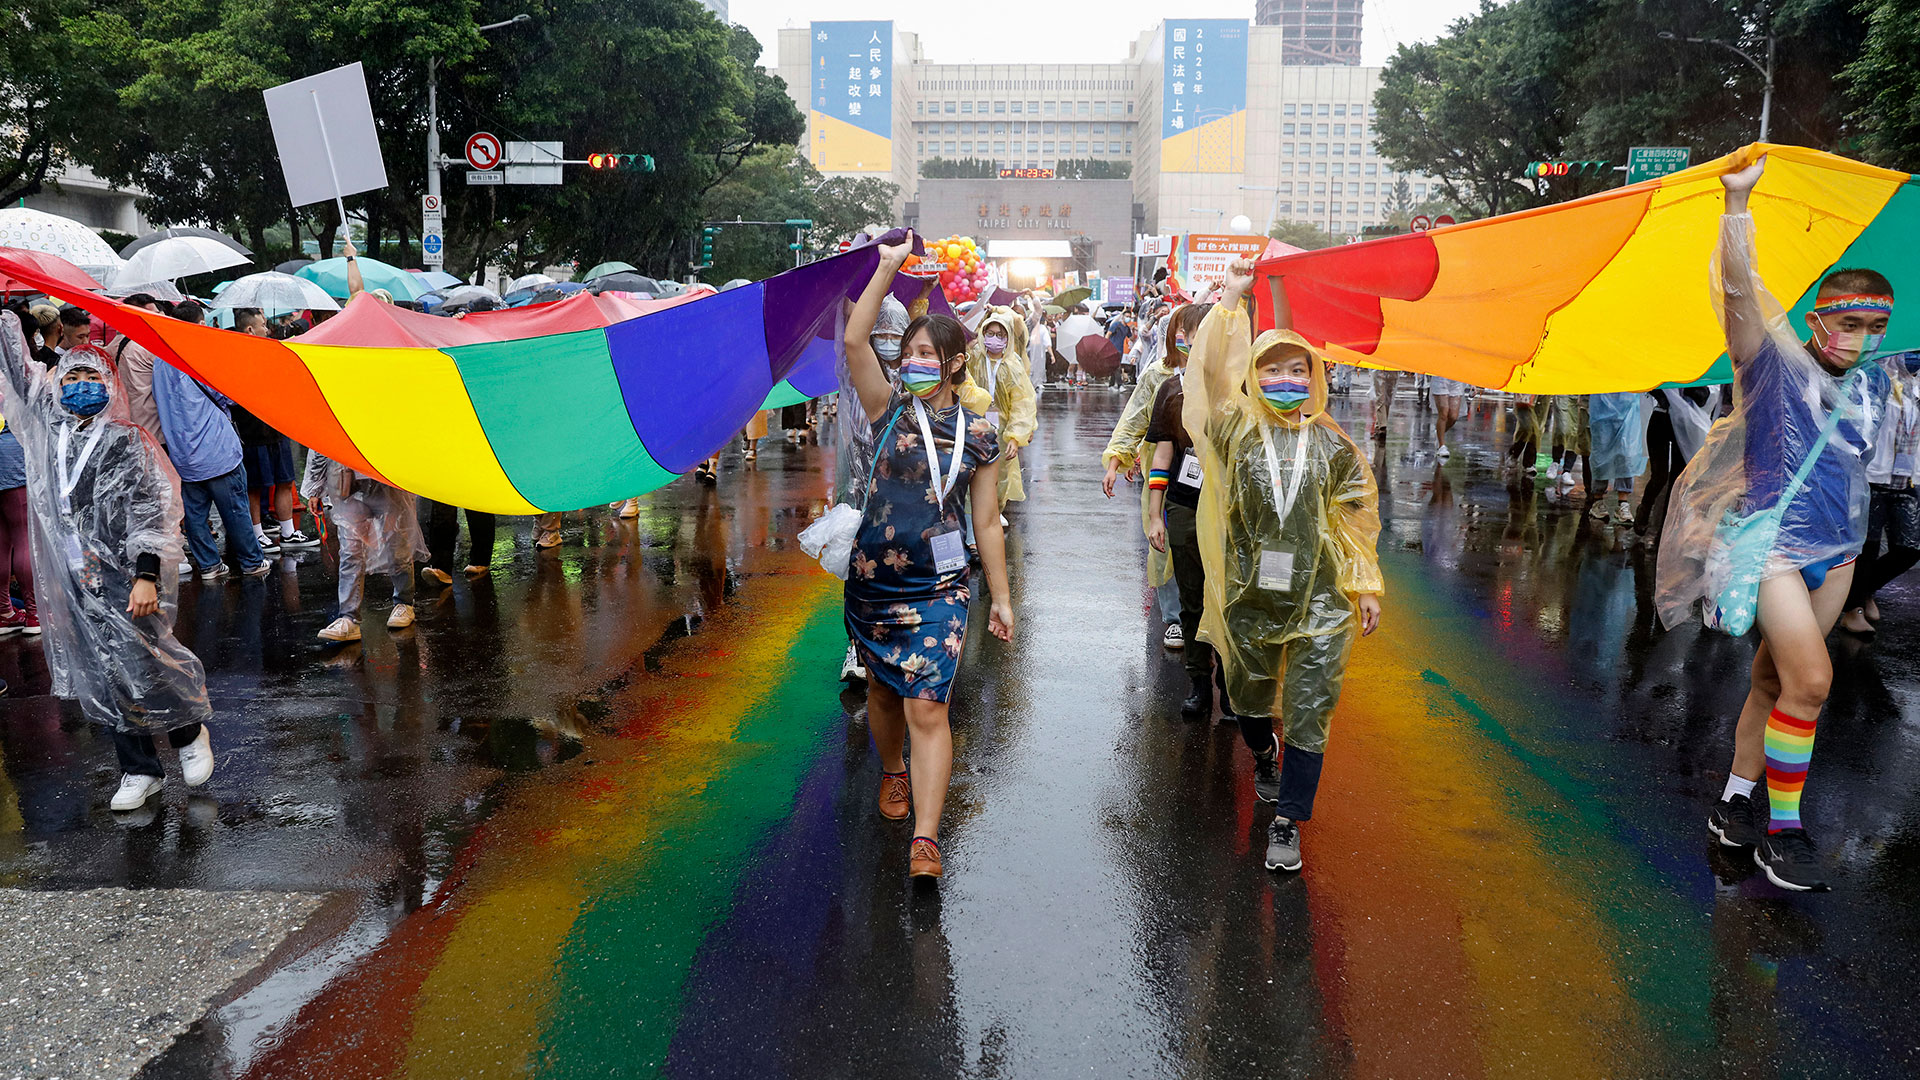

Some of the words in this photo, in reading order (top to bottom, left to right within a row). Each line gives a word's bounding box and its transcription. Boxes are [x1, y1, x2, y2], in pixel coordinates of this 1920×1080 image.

[848, 53, 862, 116] 一起改變
[869, 29, 882, 97] 人民參與
[1171, 28, 1187, 129] 國民法官上場
[1193, 28, 1203, 94] 2023年
[978, 219, 1010, 229] TAIPEI
[1017, 219, 1040, 229] CITY
[1047, 219, 1071, 229] HALL
[1143, 240, 1160, 254] U=U
